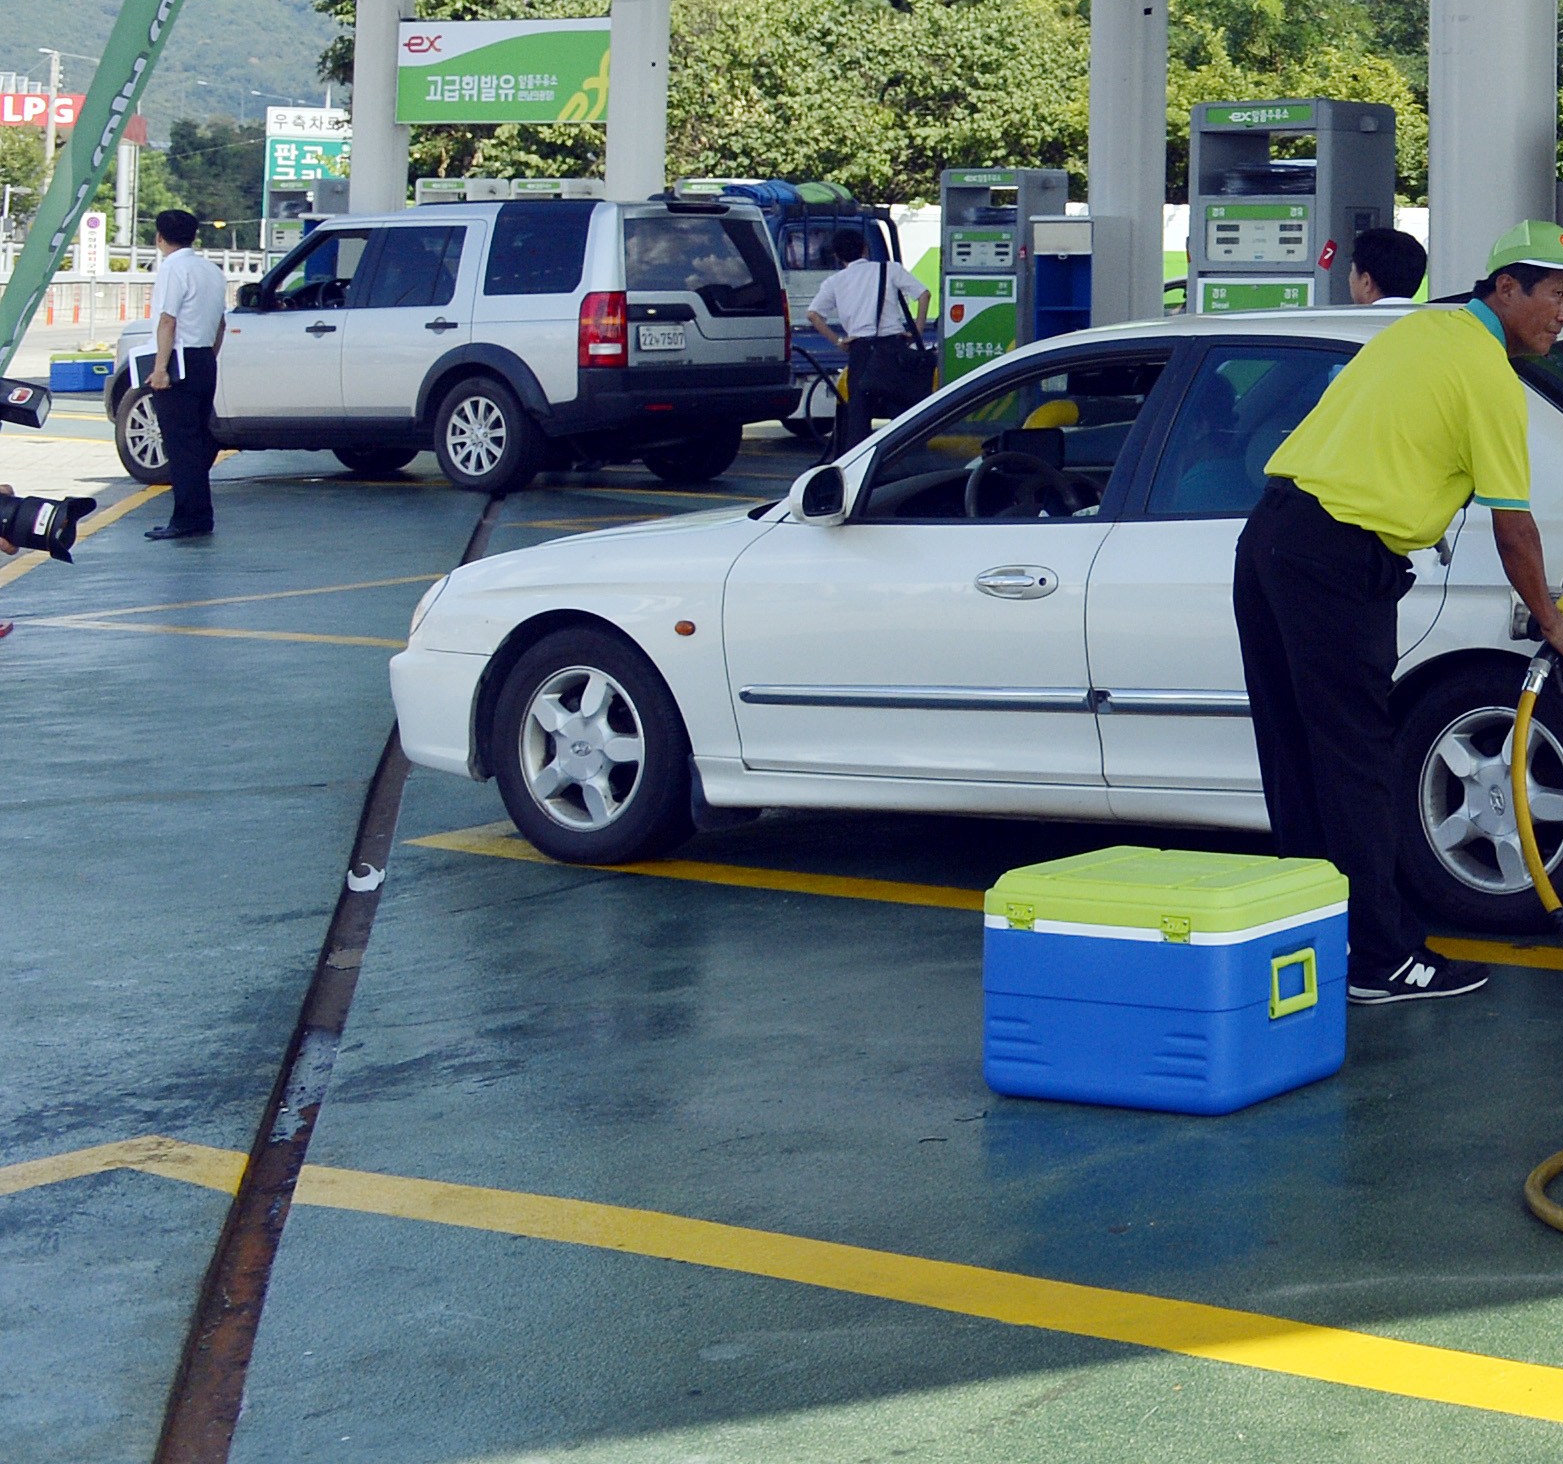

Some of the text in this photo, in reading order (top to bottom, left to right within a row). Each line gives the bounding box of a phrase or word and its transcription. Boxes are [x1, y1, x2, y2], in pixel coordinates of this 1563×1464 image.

[403, 35, 442, 54] ex
[425, 74, 516, 103] 고급휘발유
[2, 96, 76, 124] LPG
